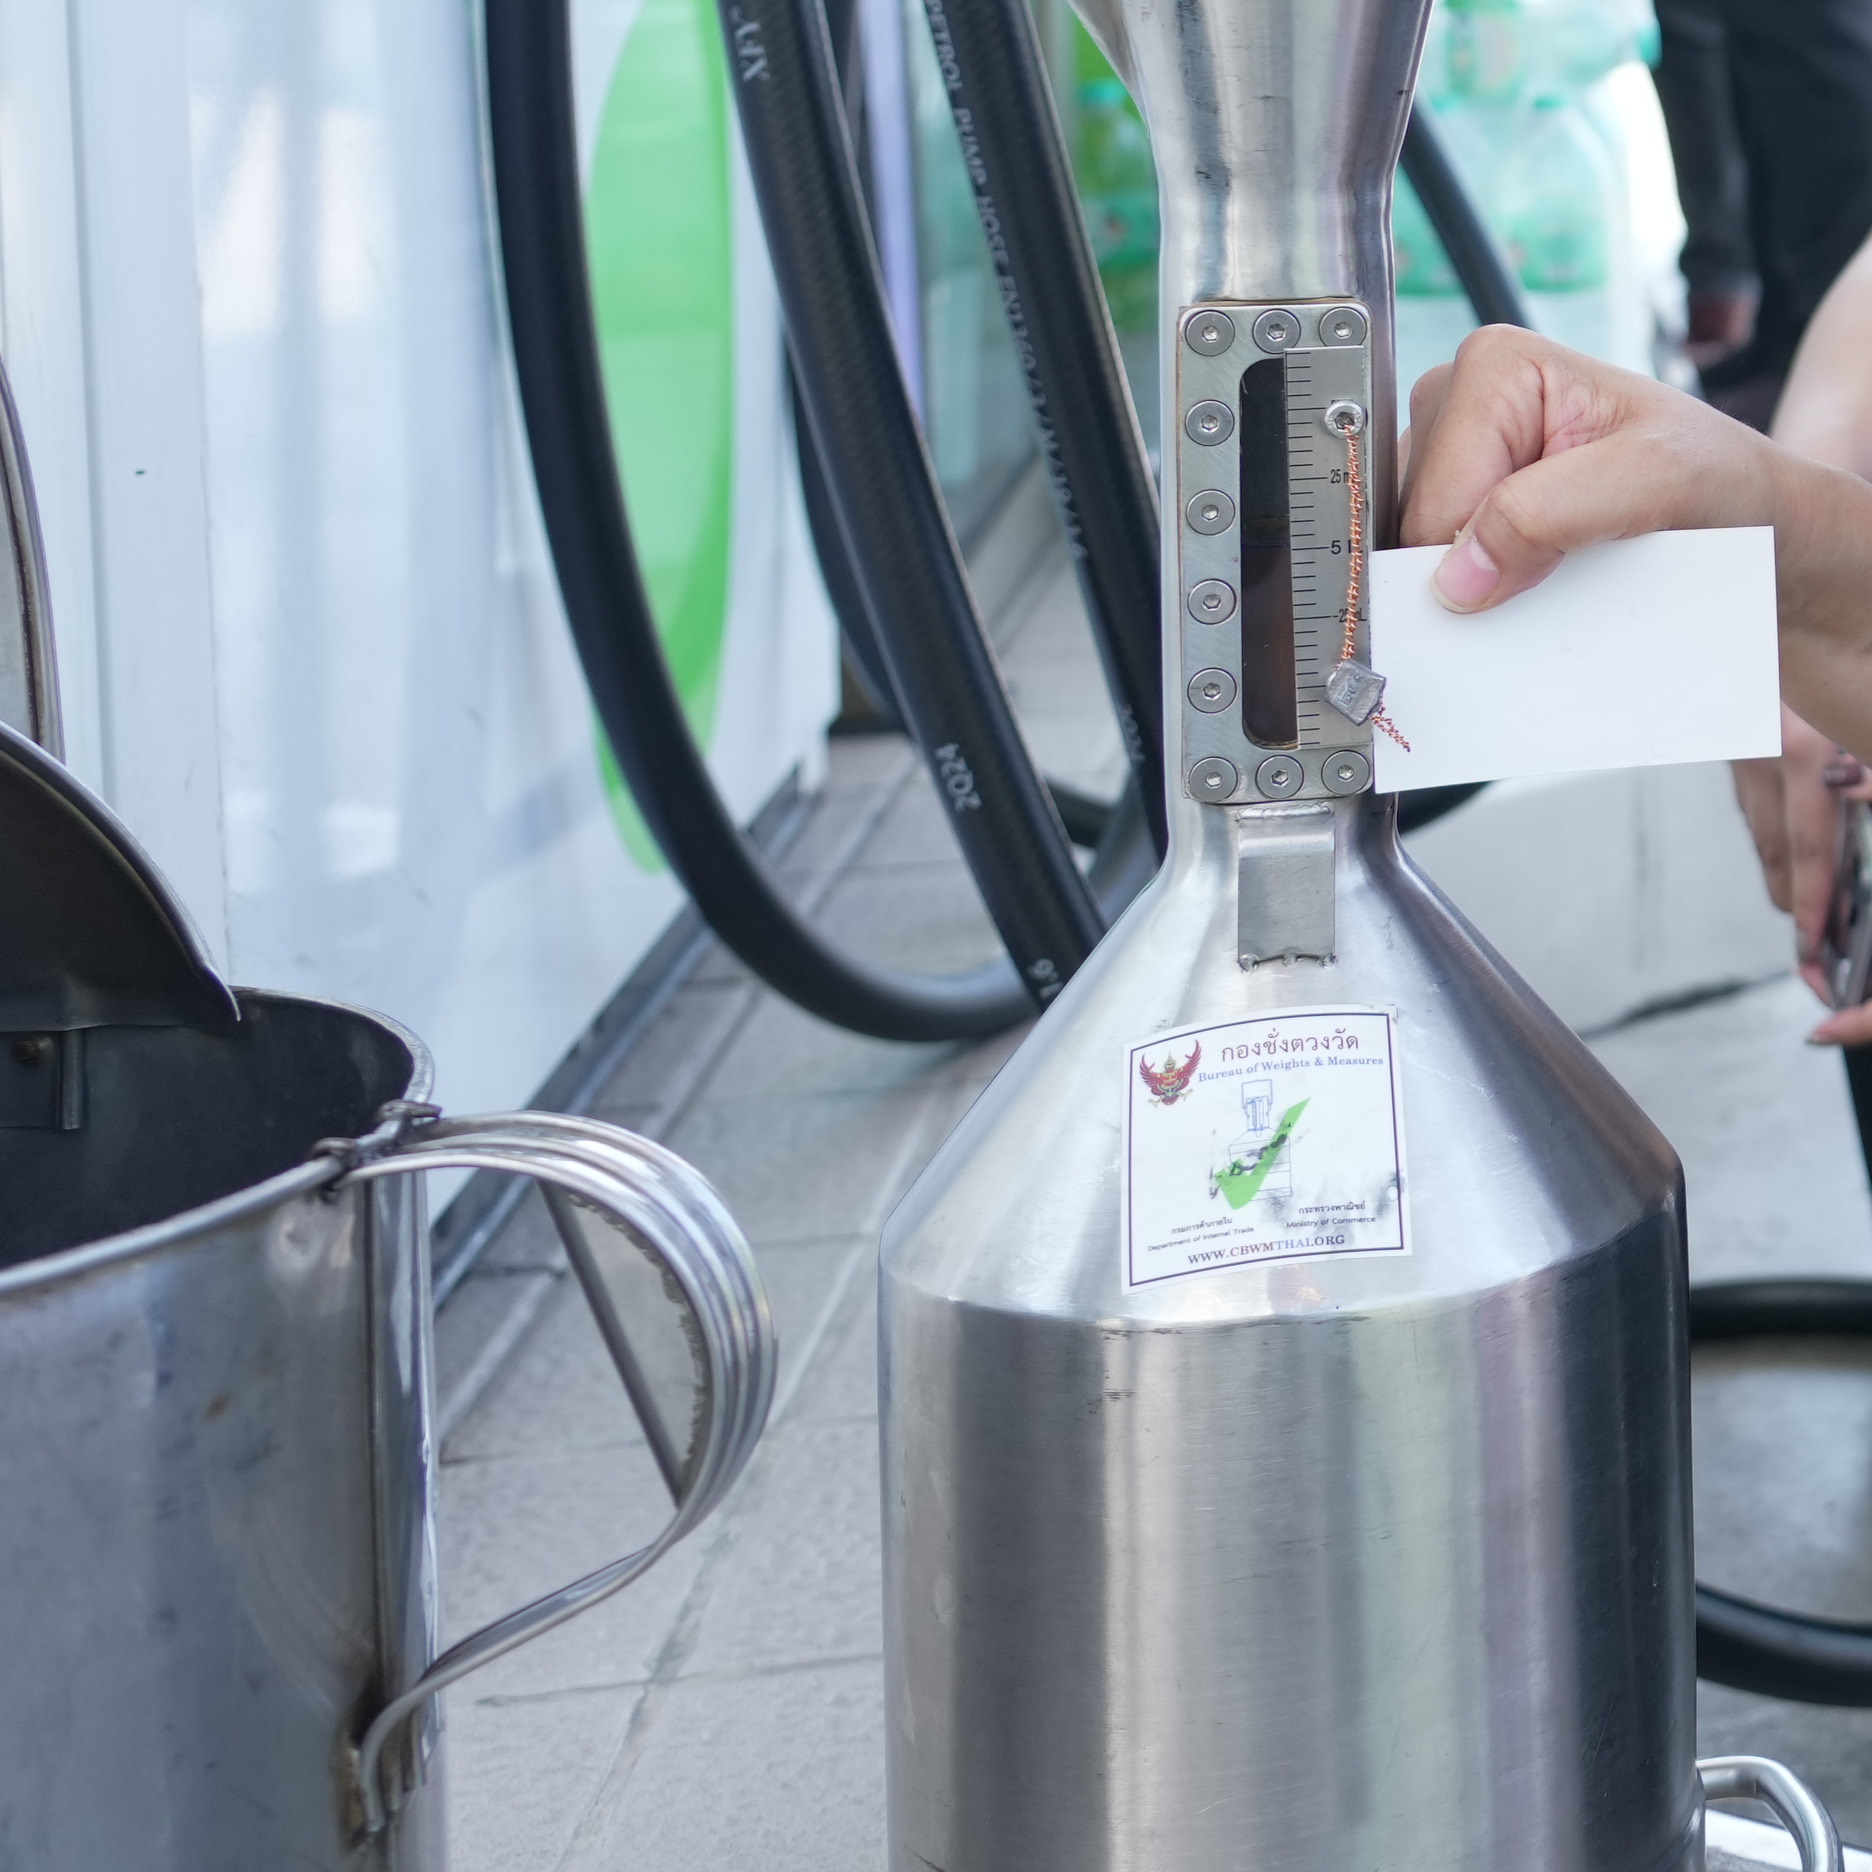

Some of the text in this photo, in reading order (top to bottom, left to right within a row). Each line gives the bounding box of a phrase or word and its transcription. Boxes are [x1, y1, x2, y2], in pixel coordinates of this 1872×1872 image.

[1330, 468, 1341, 484] 25
[1330, 539, 1342, 555] 5
[1221, 1027, 1359, 1062] กองชั่งตวงวัด
[1198, 1056, 1384, 1082] Bureau of Weights & Measures
[1171, 1216, 1233, 1235] กรมการค้าภายใน
[1286, 1219, 1318, 1228] Ministry
[1332, 1216, 1376, 1225] Commerce
[1148, 1237, 1191, 1252] Department
[1203, 1231, 1231, 1240] Internal
[1234, 1227, 1254, 1235] Trade
[1188, 1234, 1345, 1264] WWW.CBWMTHAI.ORG
